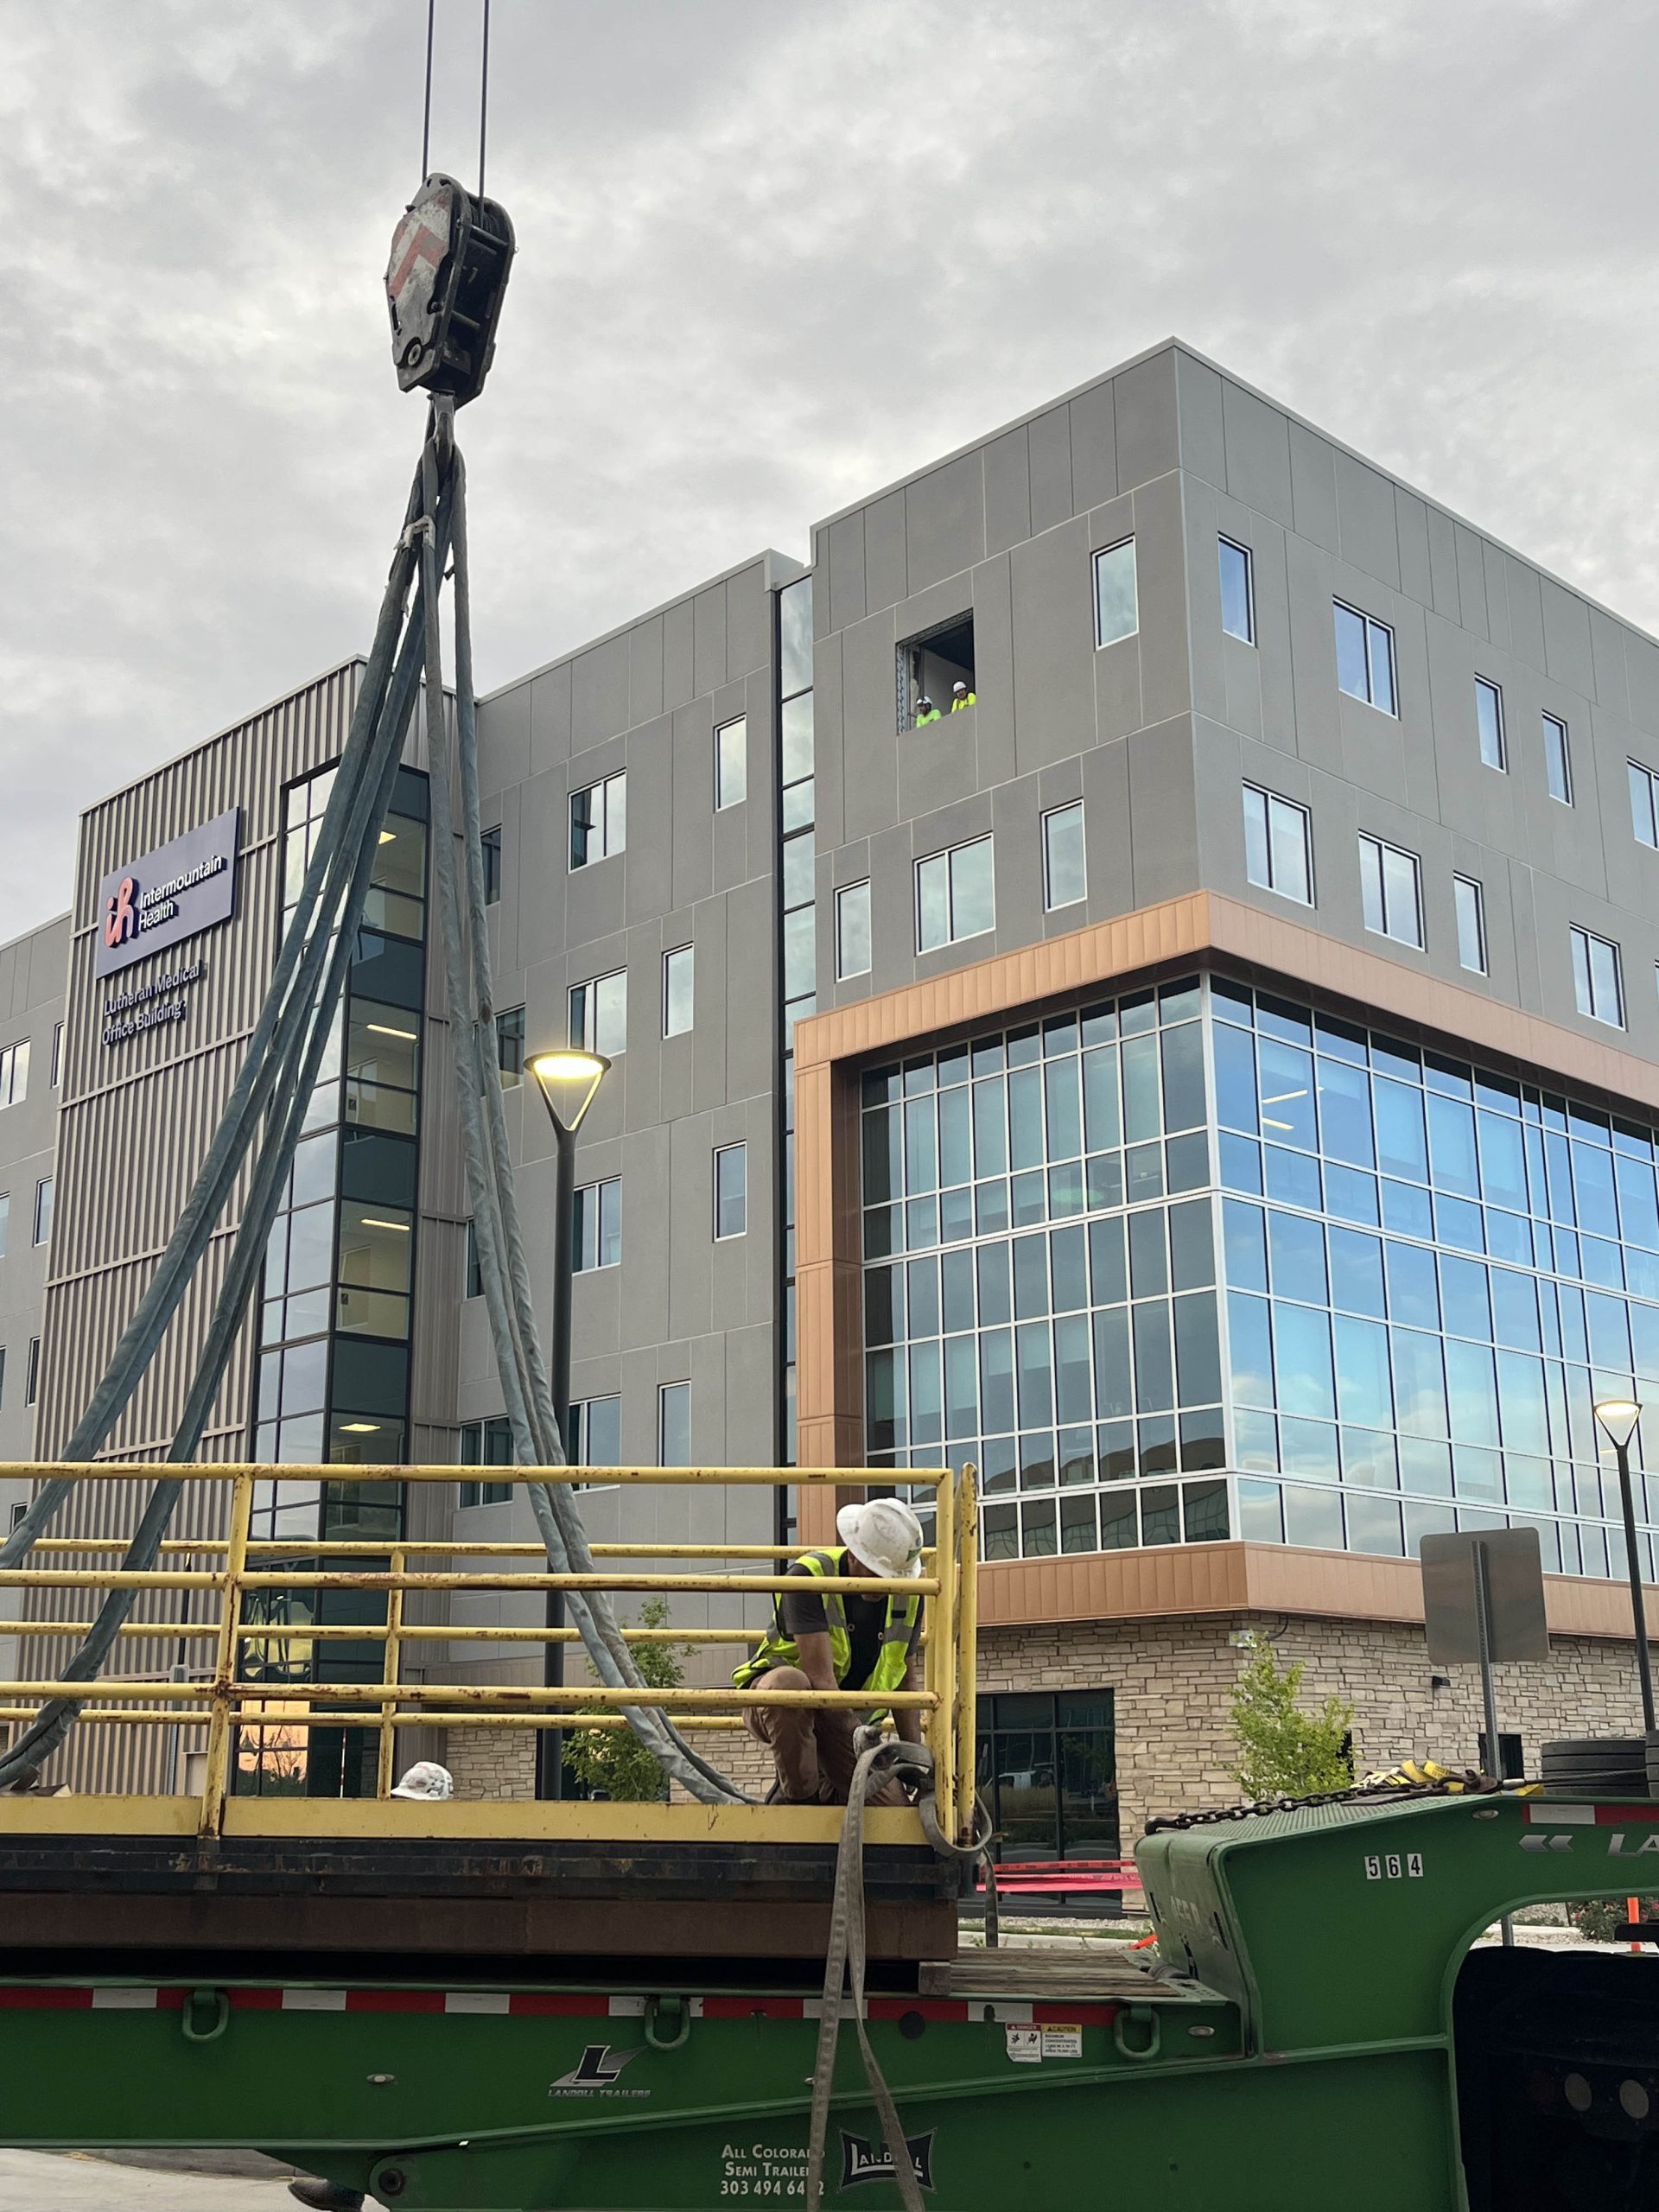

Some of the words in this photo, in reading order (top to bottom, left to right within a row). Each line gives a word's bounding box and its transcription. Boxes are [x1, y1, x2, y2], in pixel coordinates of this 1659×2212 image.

[140, 855, 222, 909] Intermountain
[138, 900, 174, 931] Health
[104, 985, 153, 1017] Lutheran
[155, 961, 200, 994] Medical
[102, 1022, 135, 1046] Office
[136, 1000, 182, 1031] Building
[1367, 1854, 1421, 1878] 564
[721, 2181, 748, 2196] 303
[753, 2181, 781, 2196] 494
[787, 2180, 824, 2196] 642
